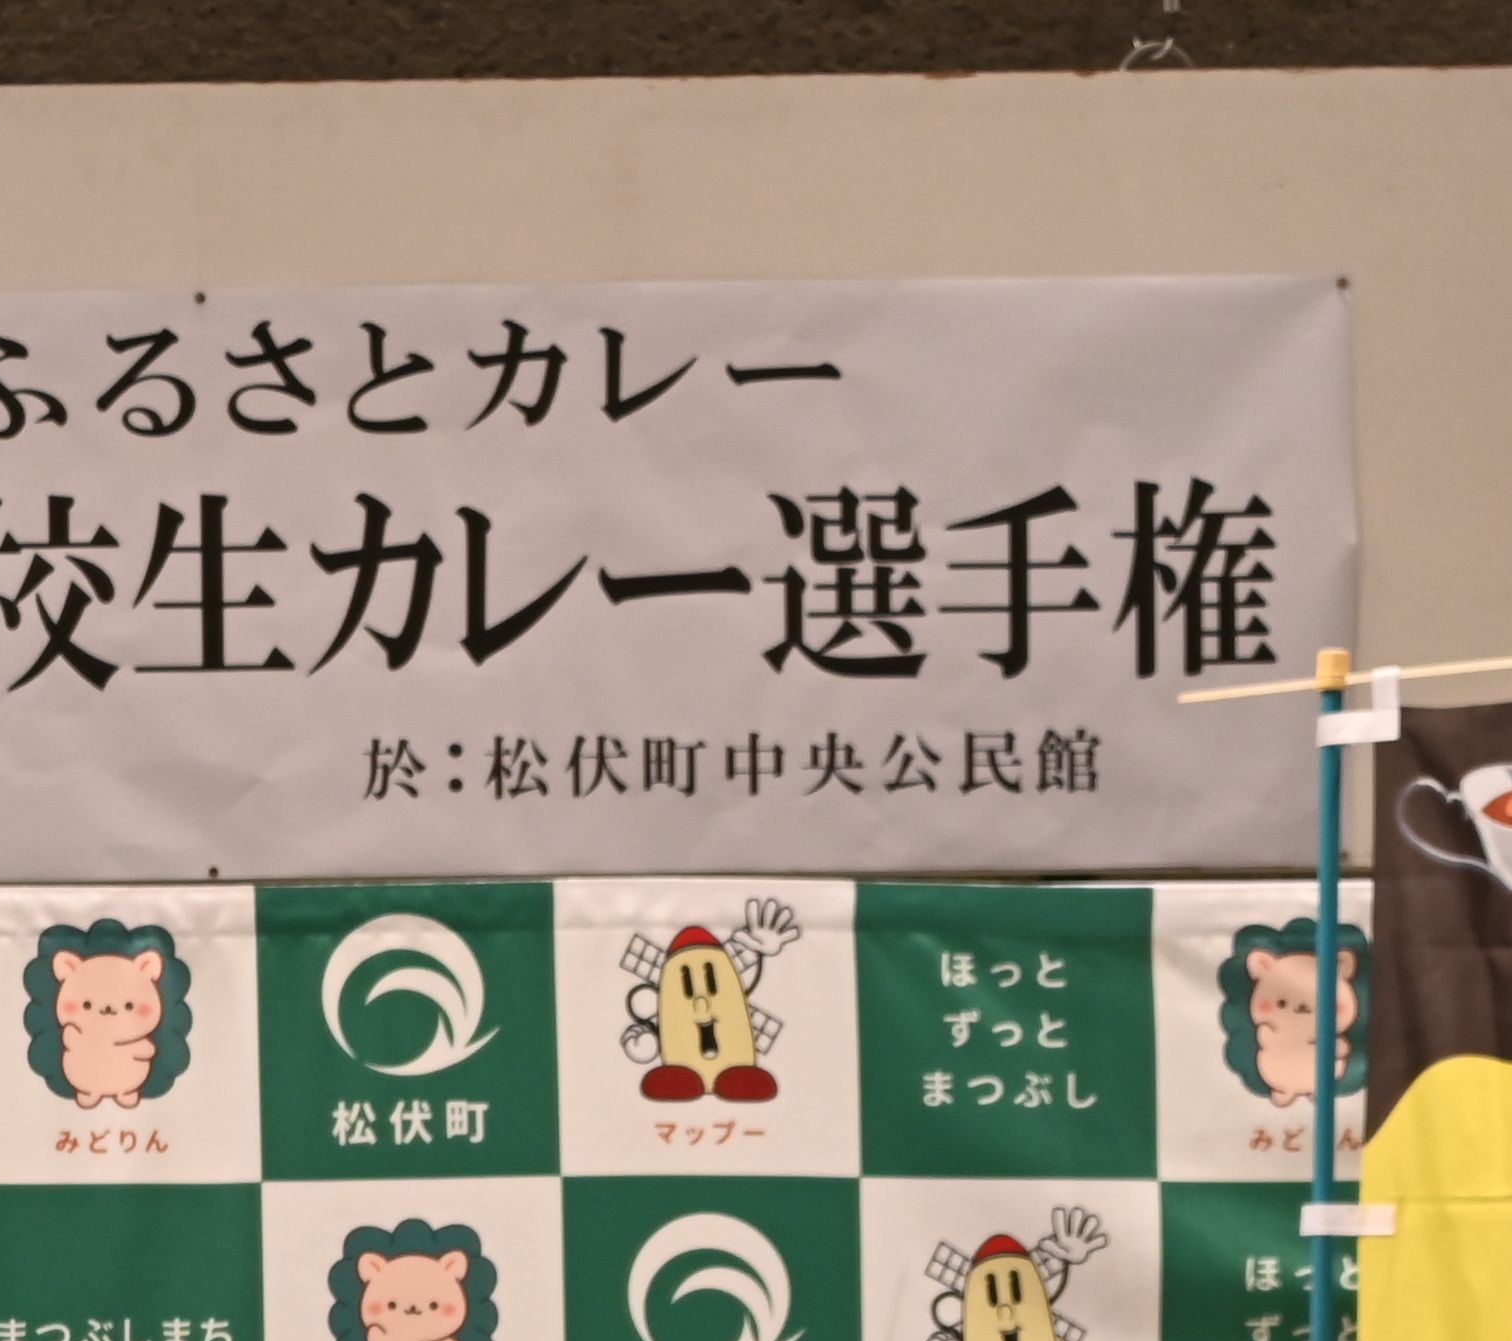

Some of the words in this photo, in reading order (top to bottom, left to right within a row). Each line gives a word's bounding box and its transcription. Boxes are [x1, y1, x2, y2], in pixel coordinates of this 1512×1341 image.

[939, 951, 1067, 989] ほっと
[942, 1009, 1068, 1049] ずっと
[921, 1070, 1098, 1109] まつぶし
[54, 1128, 170, 1155] みどりん
[331, 1098, 490, 1147] 松伏町
[653, 1119, 766, 1147] マップー
[1248, 1127, 1362, 1154] みどん
